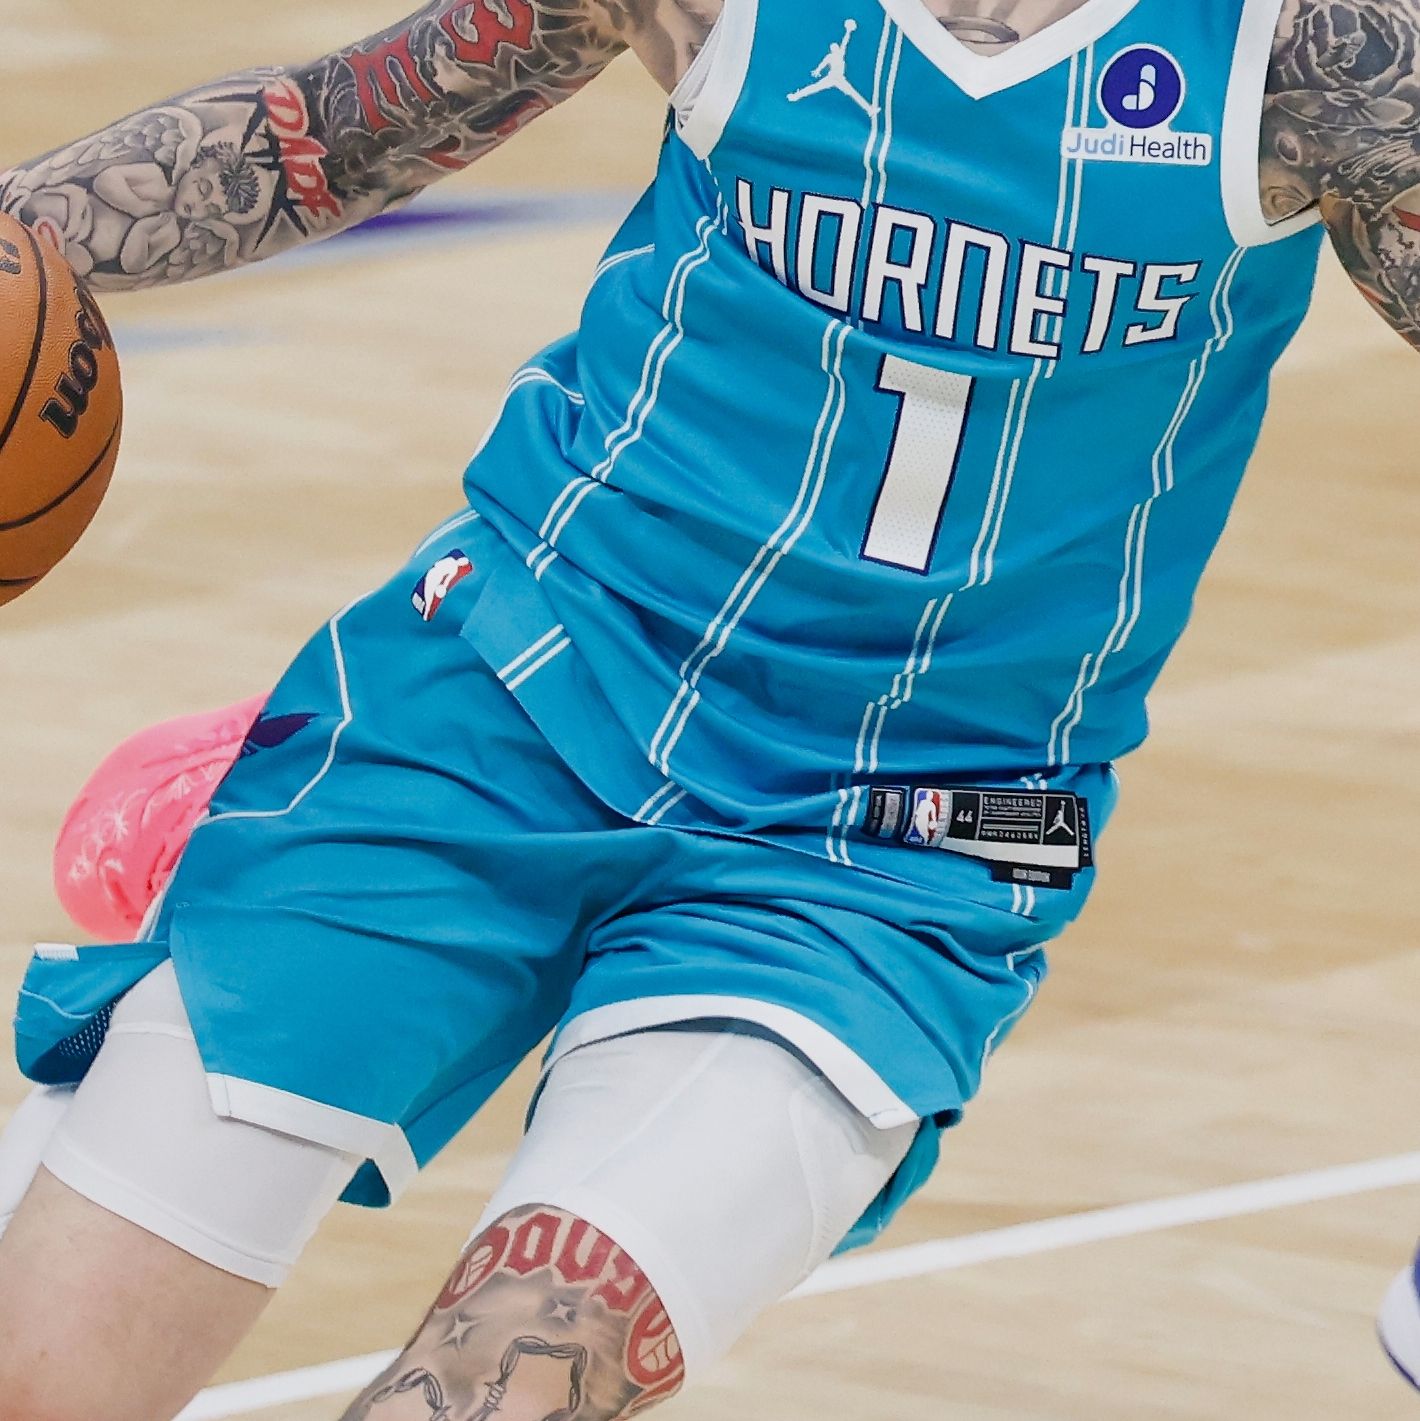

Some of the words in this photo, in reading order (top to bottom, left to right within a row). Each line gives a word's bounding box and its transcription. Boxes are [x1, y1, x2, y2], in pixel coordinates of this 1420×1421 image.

[1066, 132, 1124, 157] Judi
[1129, 134, 1207, 161] Health
[734, 176, 1203, 360] HORNETS
[858, 351, 975, 575] 1
[955, 809, 974, 823] 44
